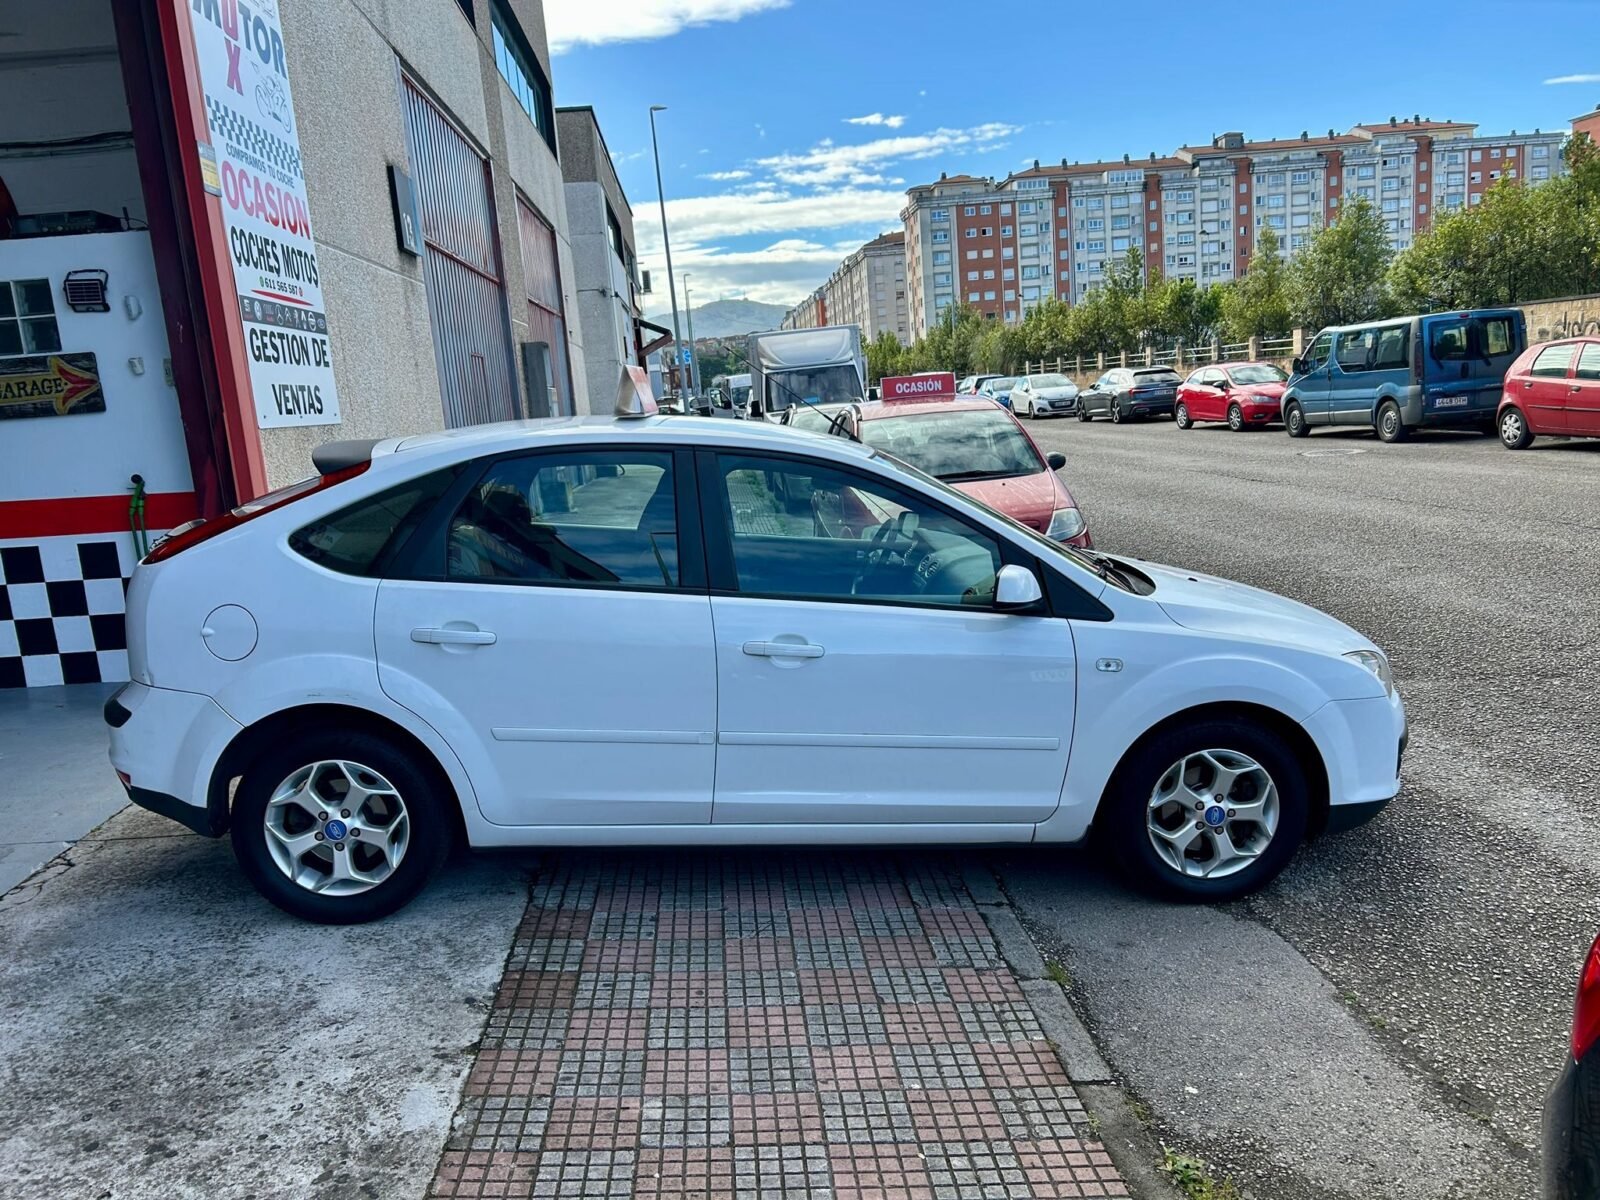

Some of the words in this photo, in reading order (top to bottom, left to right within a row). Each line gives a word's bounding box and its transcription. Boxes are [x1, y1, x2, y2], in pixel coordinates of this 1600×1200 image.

[226, 142, 266, 174] COMPRAMOS
[267, 164, 276, 179] TU
[221, 160, 310, 240] OCASION
[230, 225, 280, 277] COCHES
[281, 243, 319, 288] MOTOS
[249, 327, 311, 367] GESTION
[313, 338, 330, 368] DE
[0, 378, 65, 399] ARAGE
[272, 383, 323, 415] VENTAS
[895, 378, 942, 394] OCASIÓN
